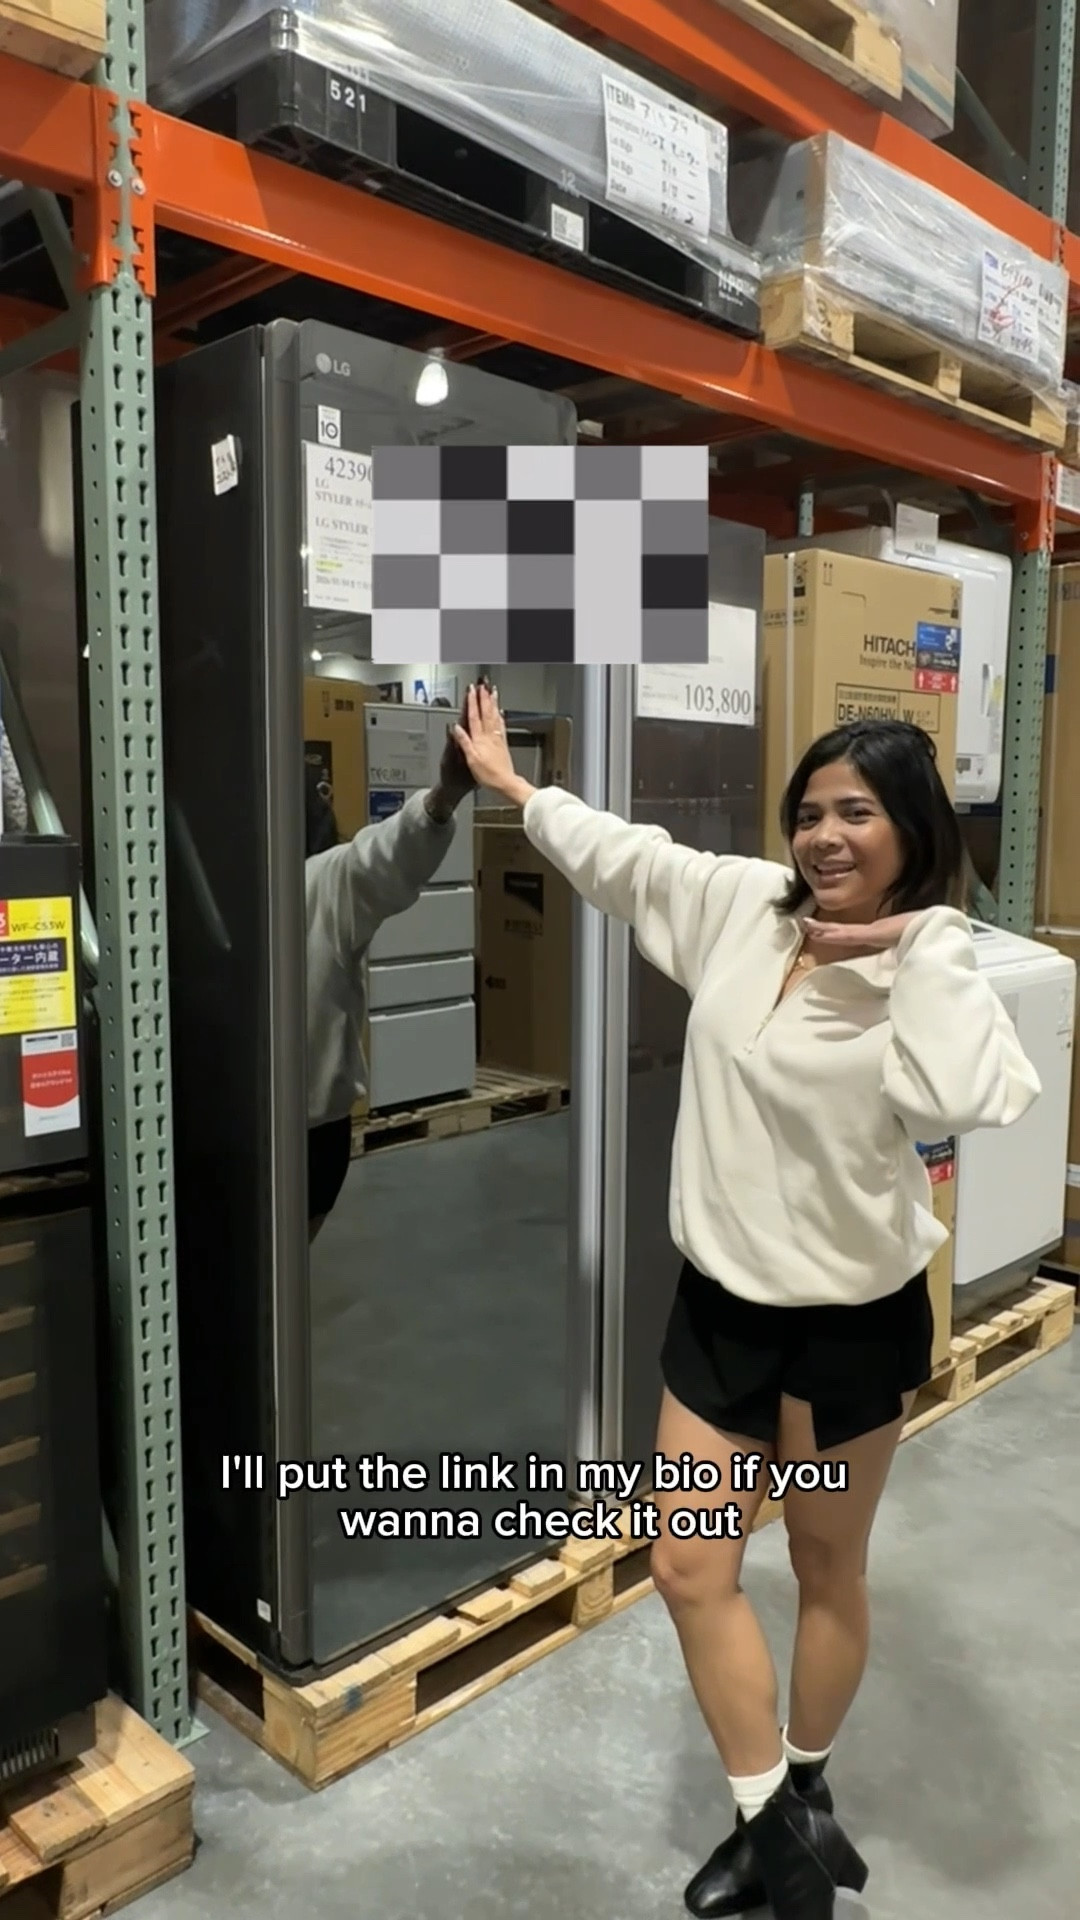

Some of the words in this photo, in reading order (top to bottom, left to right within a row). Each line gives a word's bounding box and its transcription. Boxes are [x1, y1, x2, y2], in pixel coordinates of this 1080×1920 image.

[330, 79, 366, 113] 521
[333, 359, 351, 377] LG
[321, 420, 339, 440] 10
[315, 477, 330, 489] LG
[315, 490, 353, 507] STYLER
[315, 516, 330, 529] LG
[331, 519, 369, 535] STYLER
[888, 658, 902, 670] the
[684, 683, 752, 718] 103,800
